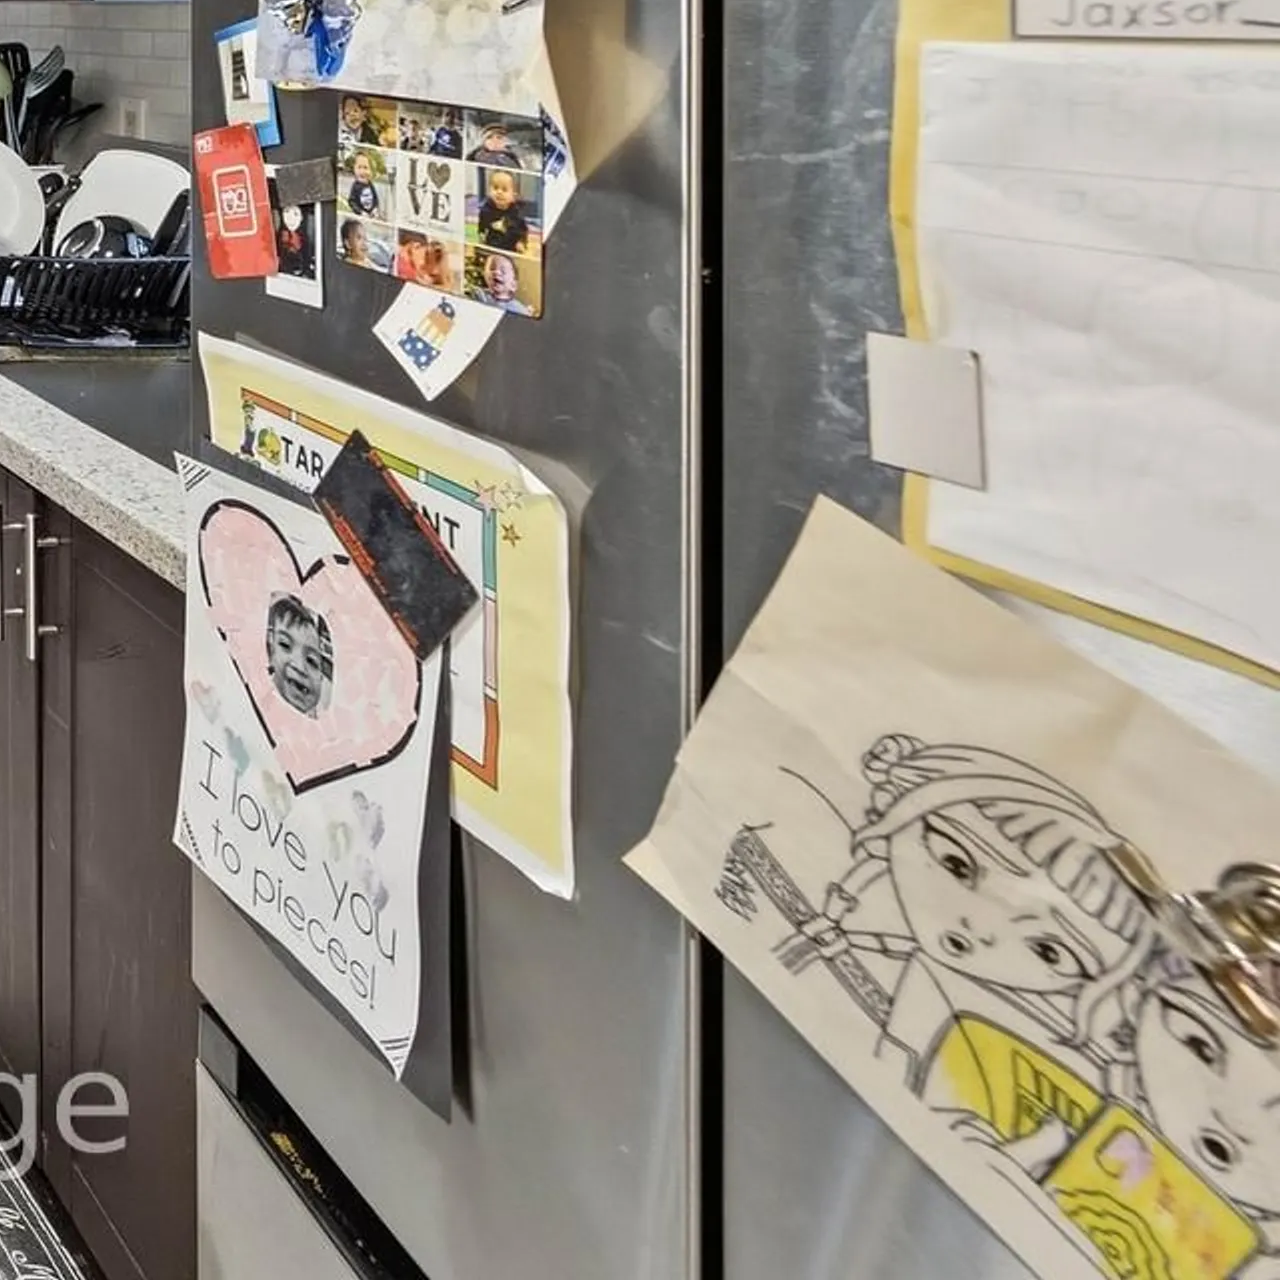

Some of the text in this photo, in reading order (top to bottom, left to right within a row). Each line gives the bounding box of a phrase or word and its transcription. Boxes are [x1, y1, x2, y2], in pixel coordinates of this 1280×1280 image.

[199, 740, 397, 967] I love you
[212, 819, 376, 1011] to pieces!
